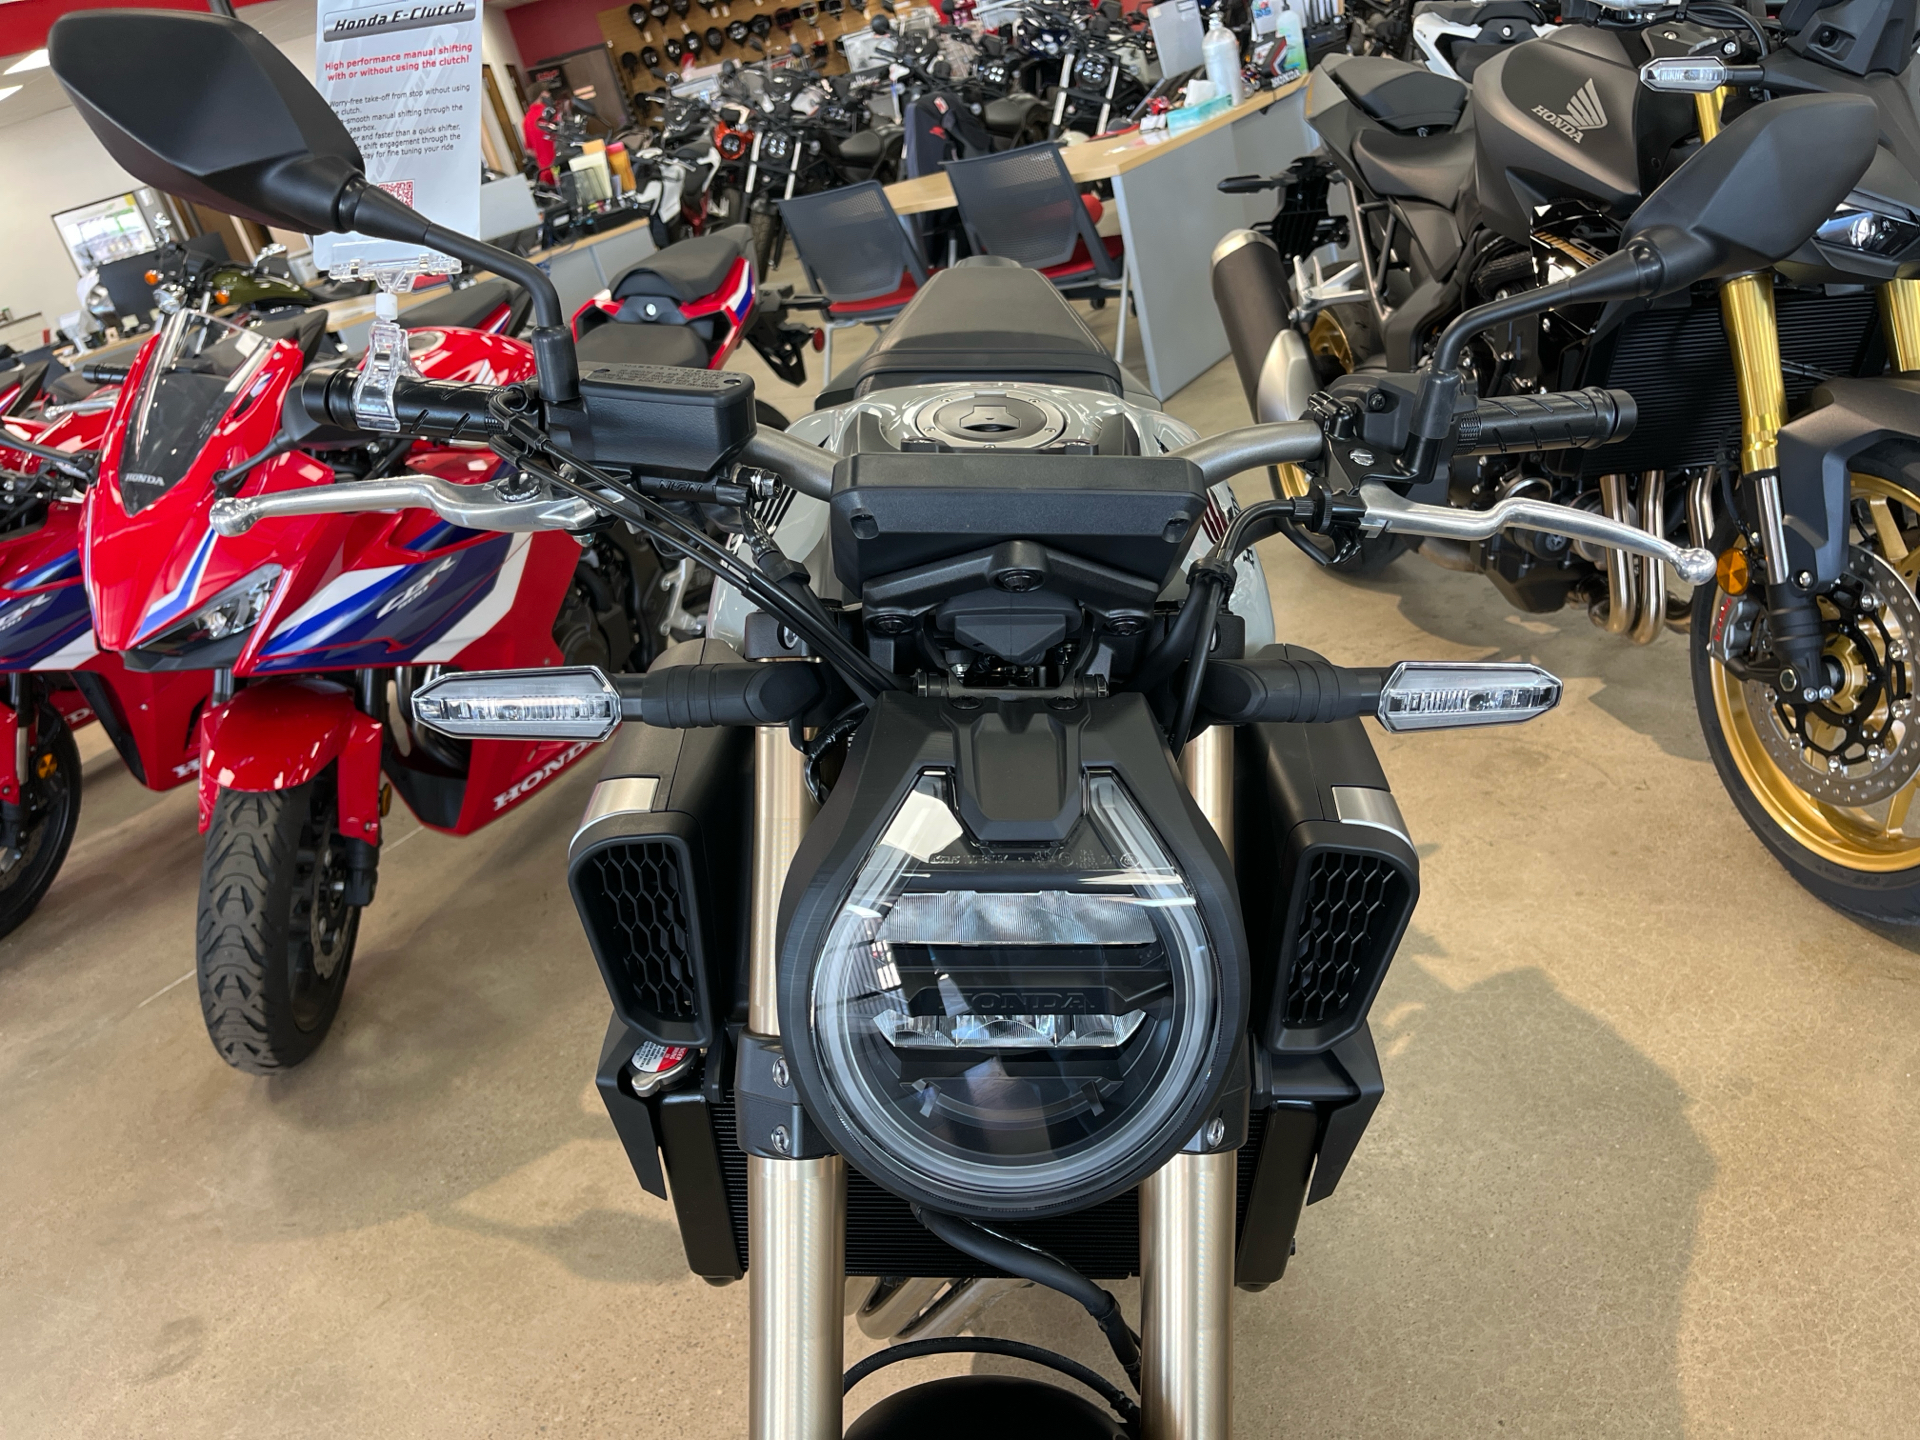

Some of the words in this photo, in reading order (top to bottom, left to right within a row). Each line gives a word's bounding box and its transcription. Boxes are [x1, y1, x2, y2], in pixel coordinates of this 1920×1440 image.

[334, 14, 388, 32] Honda
[391, 1, 466, 24] E-Clutch
[325, 60, 344, 71] High
[346, 54, 401, 72] performance
[403, 47, 436, 60] manual
[438, 43, 473, 55] shifting
[327, 69, 347, 81] with
[349, 71, 357, 79] or
[360, 65, 393, 77] without
[396, 62, 419, 73] using
[422, 59, 437, 68] the
[439, 54, 470, 67] clutch!
[330, 97, 363, 108] Worry-free
[364, 93, 390, 104] take-off
[391, 91, 408, 100] from
[409, 90, 424, 99] stop
[425, 86, 451, 96] without
[451, 83, 471, 93] using
[341, 107, 362, 116] clutch.
[371, 112, 396, 122] manual
[397, 109, 422, 119] shifting
[423, 106, 450, 116] through
[451, 103, 463, 112] the
[349, 124, 376, 134] gearbox.
[361, 133, 374, 141] and
[375, 131, 394, 140] faster
[395, 128, 411, 136] than
[418, 126, 436, 136] quick
[1531, 104, 1584, 144] HONDA
[363, 142, 378, 150] shift
[379, 138, 421, 149] engagement
[421, 136, 449, 146] through
[449, 133, 461, 141] the
[375, 149, 386, 158] for
[386, 148, 400, 157] fine
[401, 146, 422, 156] tuning
[424, 145, 439, 154] your
[441, 143, 455, 151] ride
[124, 473, 165, 487] HONDA
[493, 741, 594, 812] HOND
